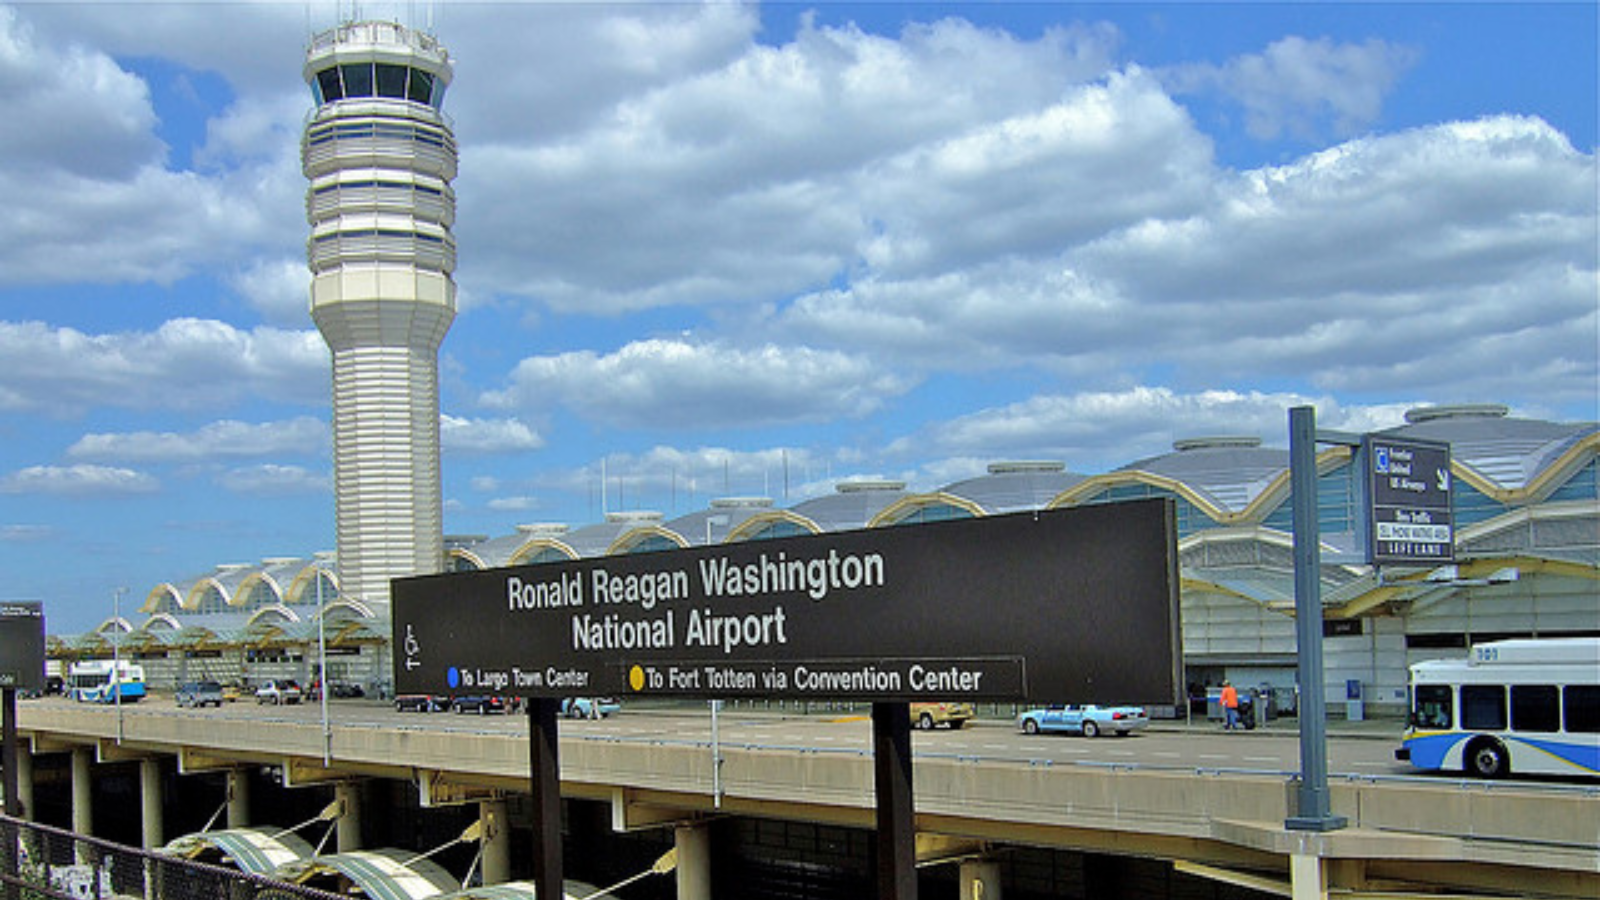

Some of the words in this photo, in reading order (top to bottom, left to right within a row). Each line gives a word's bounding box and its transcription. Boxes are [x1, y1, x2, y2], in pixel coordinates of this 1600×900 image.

[1415, 543, 1441, 555] LANE
[508, 572, 582, 610] Ronald
[593, 570, 688, 609] Reagan
[700, 548, 884, 600] Washington
[572, 608, 674, 650] National
[686, 607, 786, 653] Airport
[461, 669, 474, 686] To
[477, 668, 509, 690] Largo
[512, 668, 543, 686] Town
[547, 667, 589, 687] Center
[646, 668, 664, 688] To
[669, 667, 700, 688] Fort
[705, 667, 756, 688] Totten
[763, 668, 787, 689] via
[795, 666, 901, 690] Convention
[909, 665, 982, 691] Center
